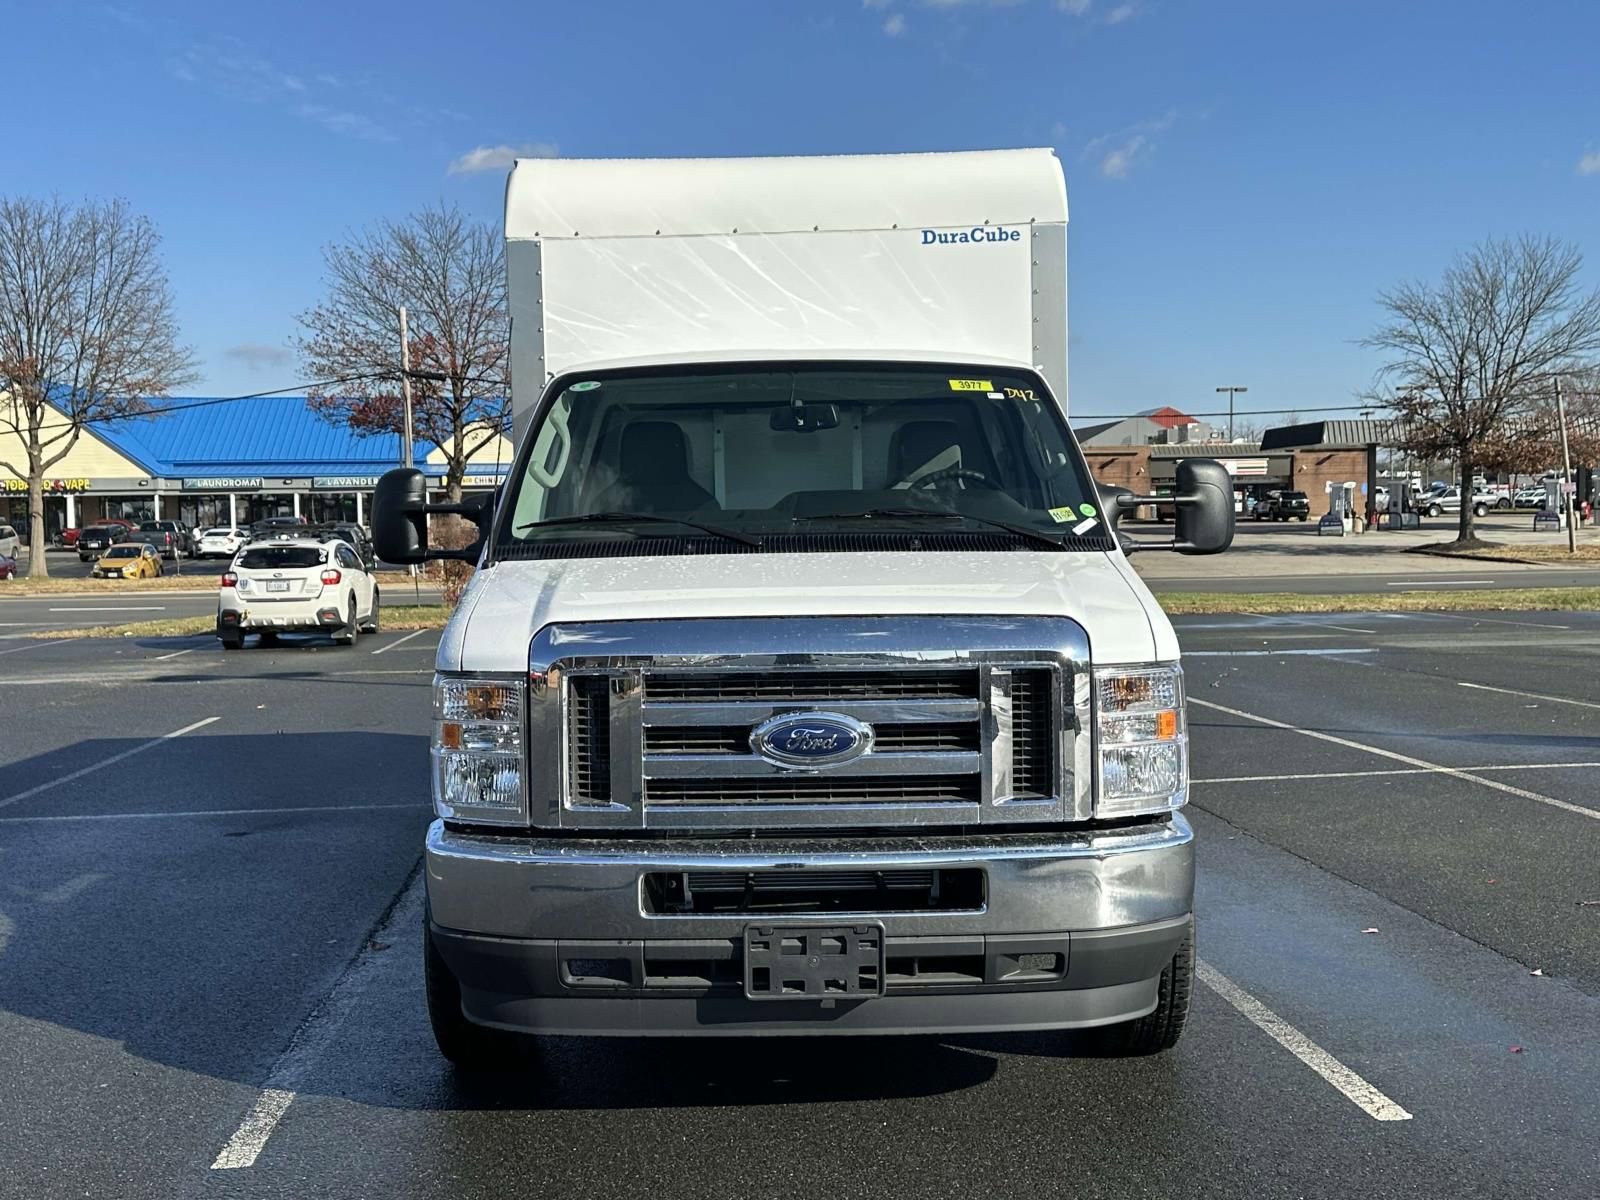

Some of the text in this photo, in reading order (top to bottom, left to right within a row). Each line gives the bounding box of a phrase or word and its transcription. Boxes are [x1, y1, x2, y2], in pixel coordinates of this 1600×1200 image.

[921, 227, 1020, 245] DuraCube
[959, 381, 982, 389] 3977
[5, 479, 90, 491] TOBAO VAPE
[197, 479, 260, 487] LAUNDROMAT
[786, 728, 838, 751] Ford
